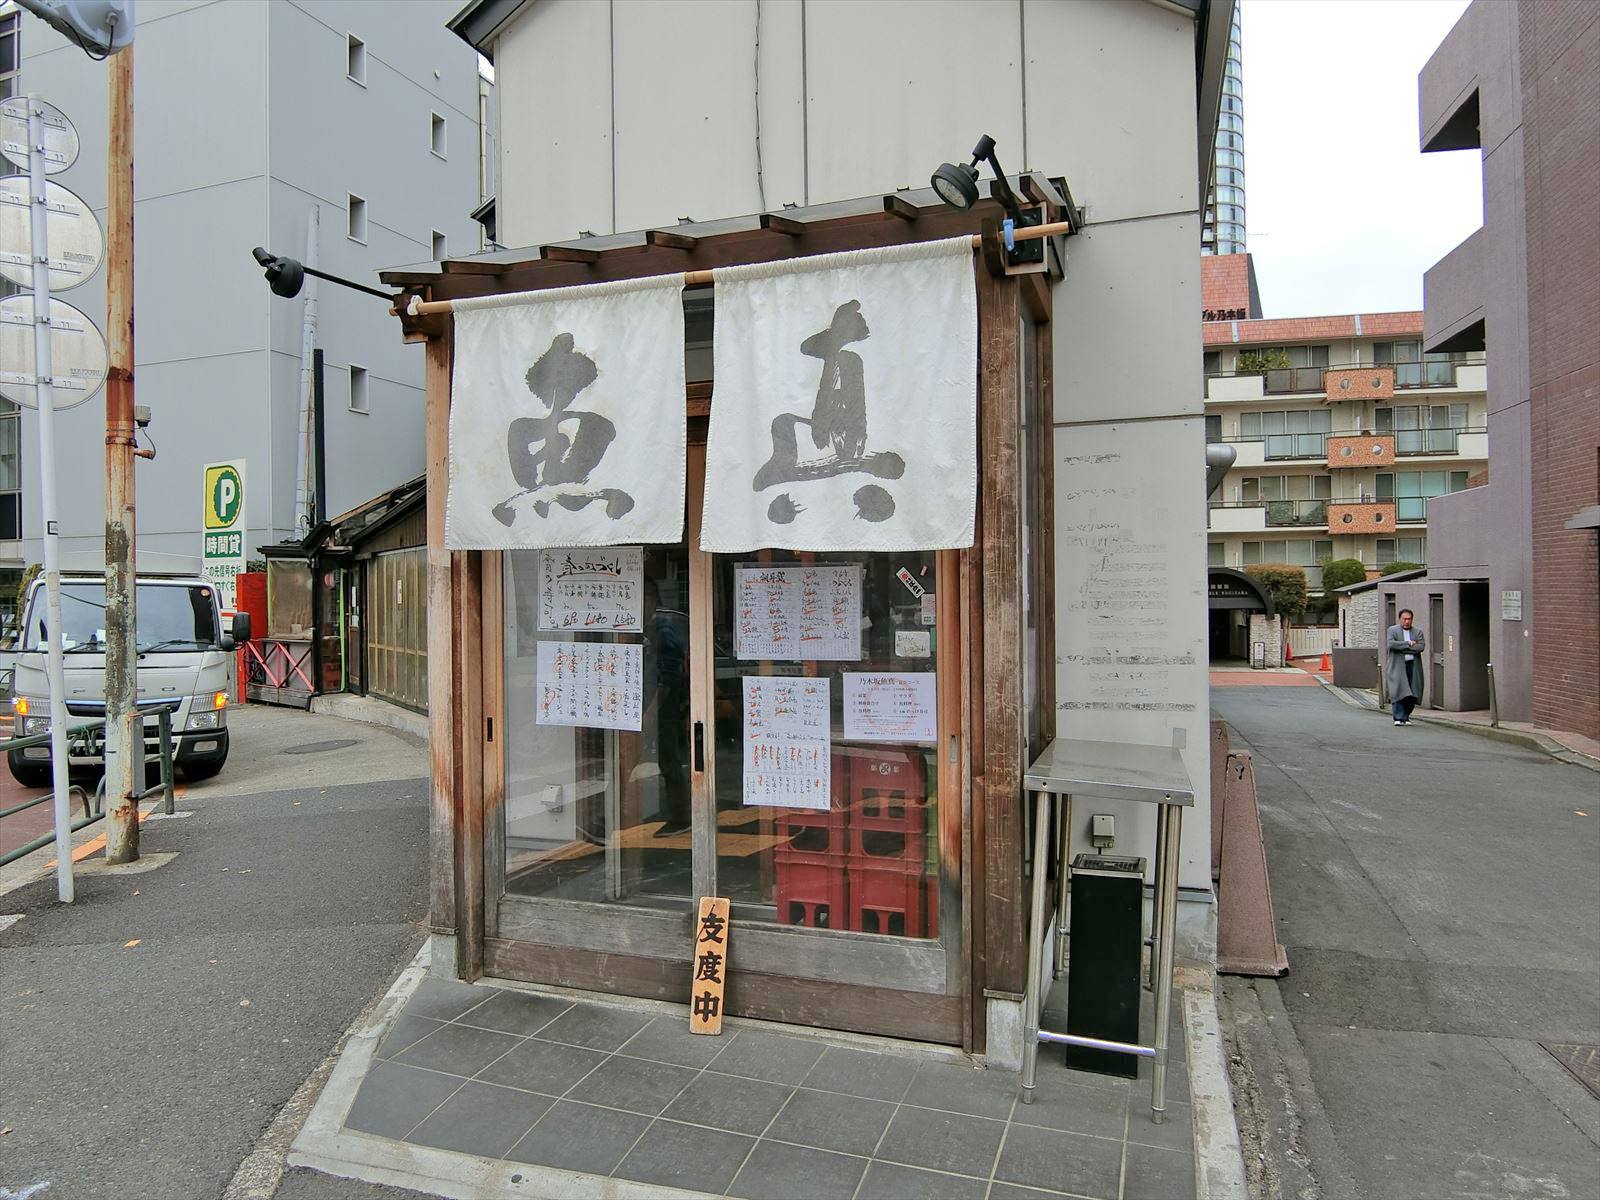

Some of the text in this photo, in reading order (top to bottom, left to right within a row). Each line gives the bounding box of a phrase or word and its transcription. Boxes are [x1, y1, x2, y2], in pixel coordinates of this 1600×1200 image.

[492, 332, 635, 527] 魚
[220, 478, 235, 517] P
[206, 534, 241, 555] 時間貸
[694, 912, 725, 1023] 支度中
